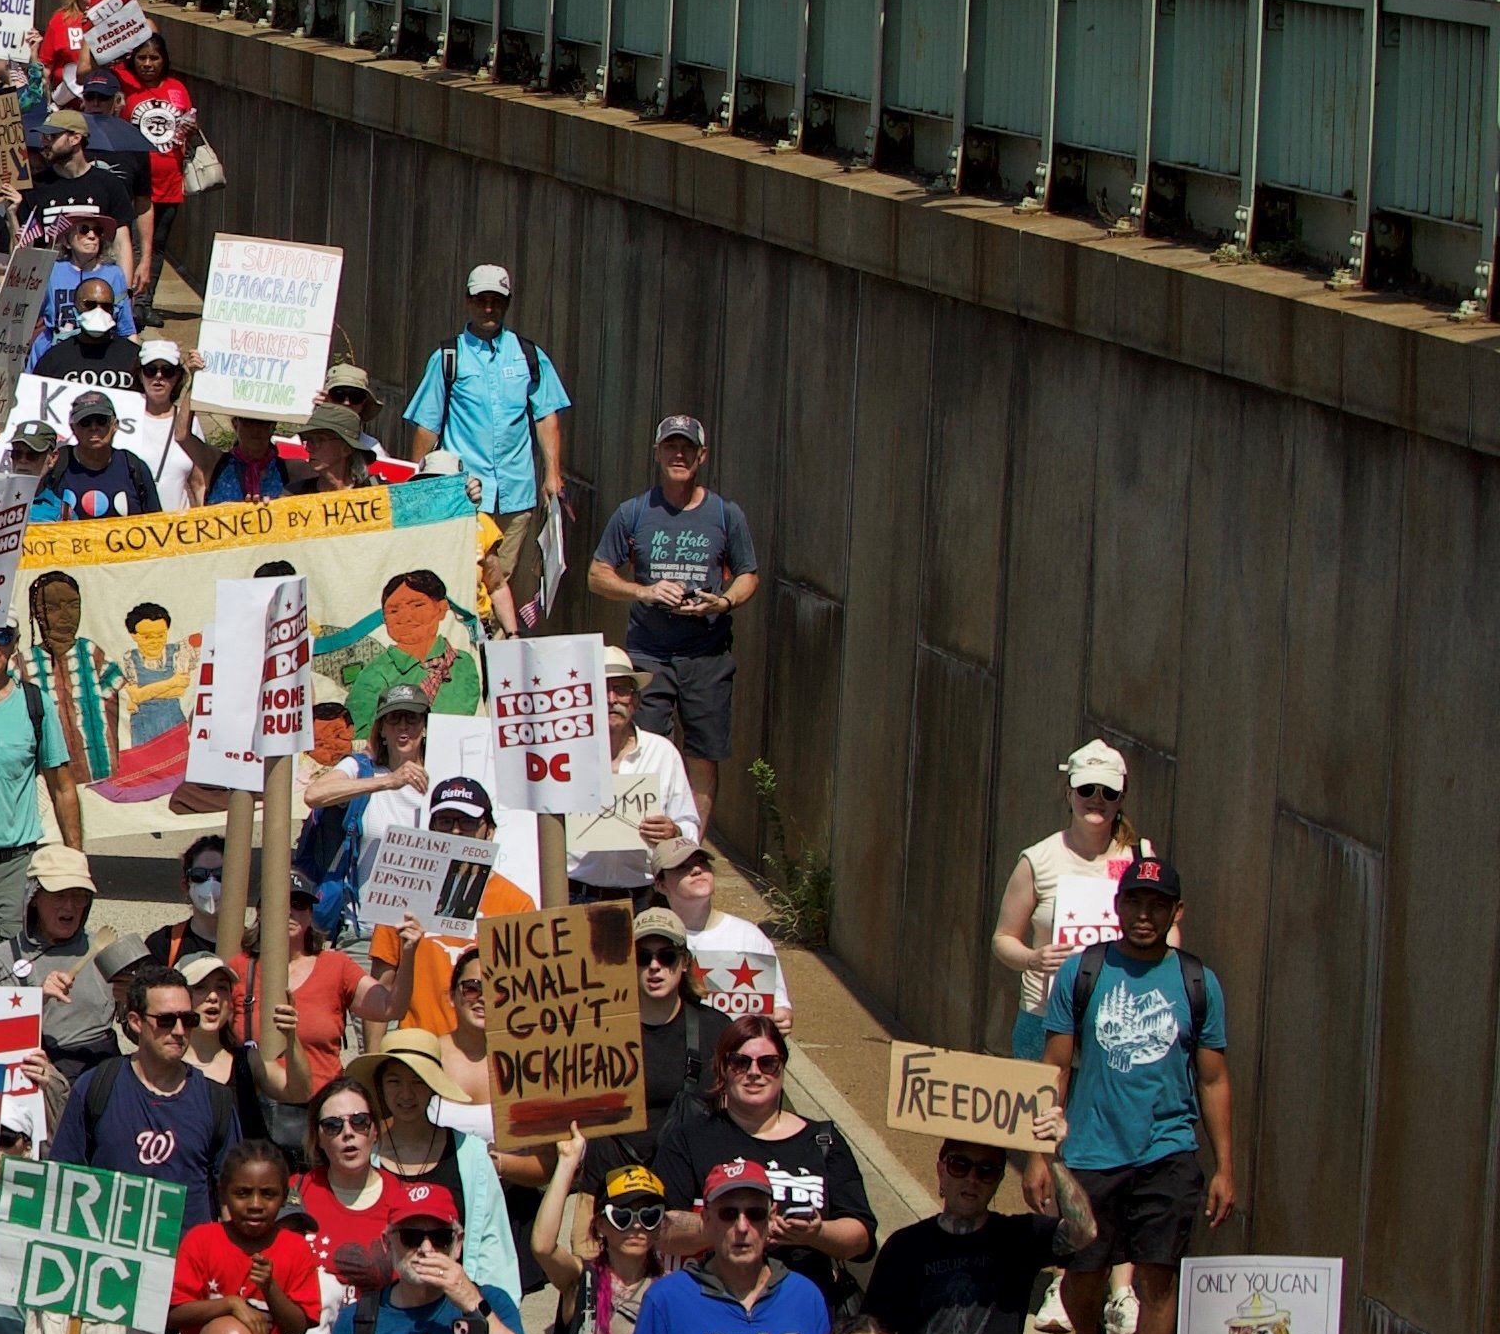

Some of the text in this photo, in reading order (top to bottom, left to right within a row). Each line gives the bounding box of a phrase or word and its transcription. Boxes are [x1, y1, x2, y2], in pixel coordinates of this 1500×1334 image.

[500, 685, 589, 715] TODOS
[498, 715, 592, 745] SOMOS
[525, 753, 569, 781] DC
